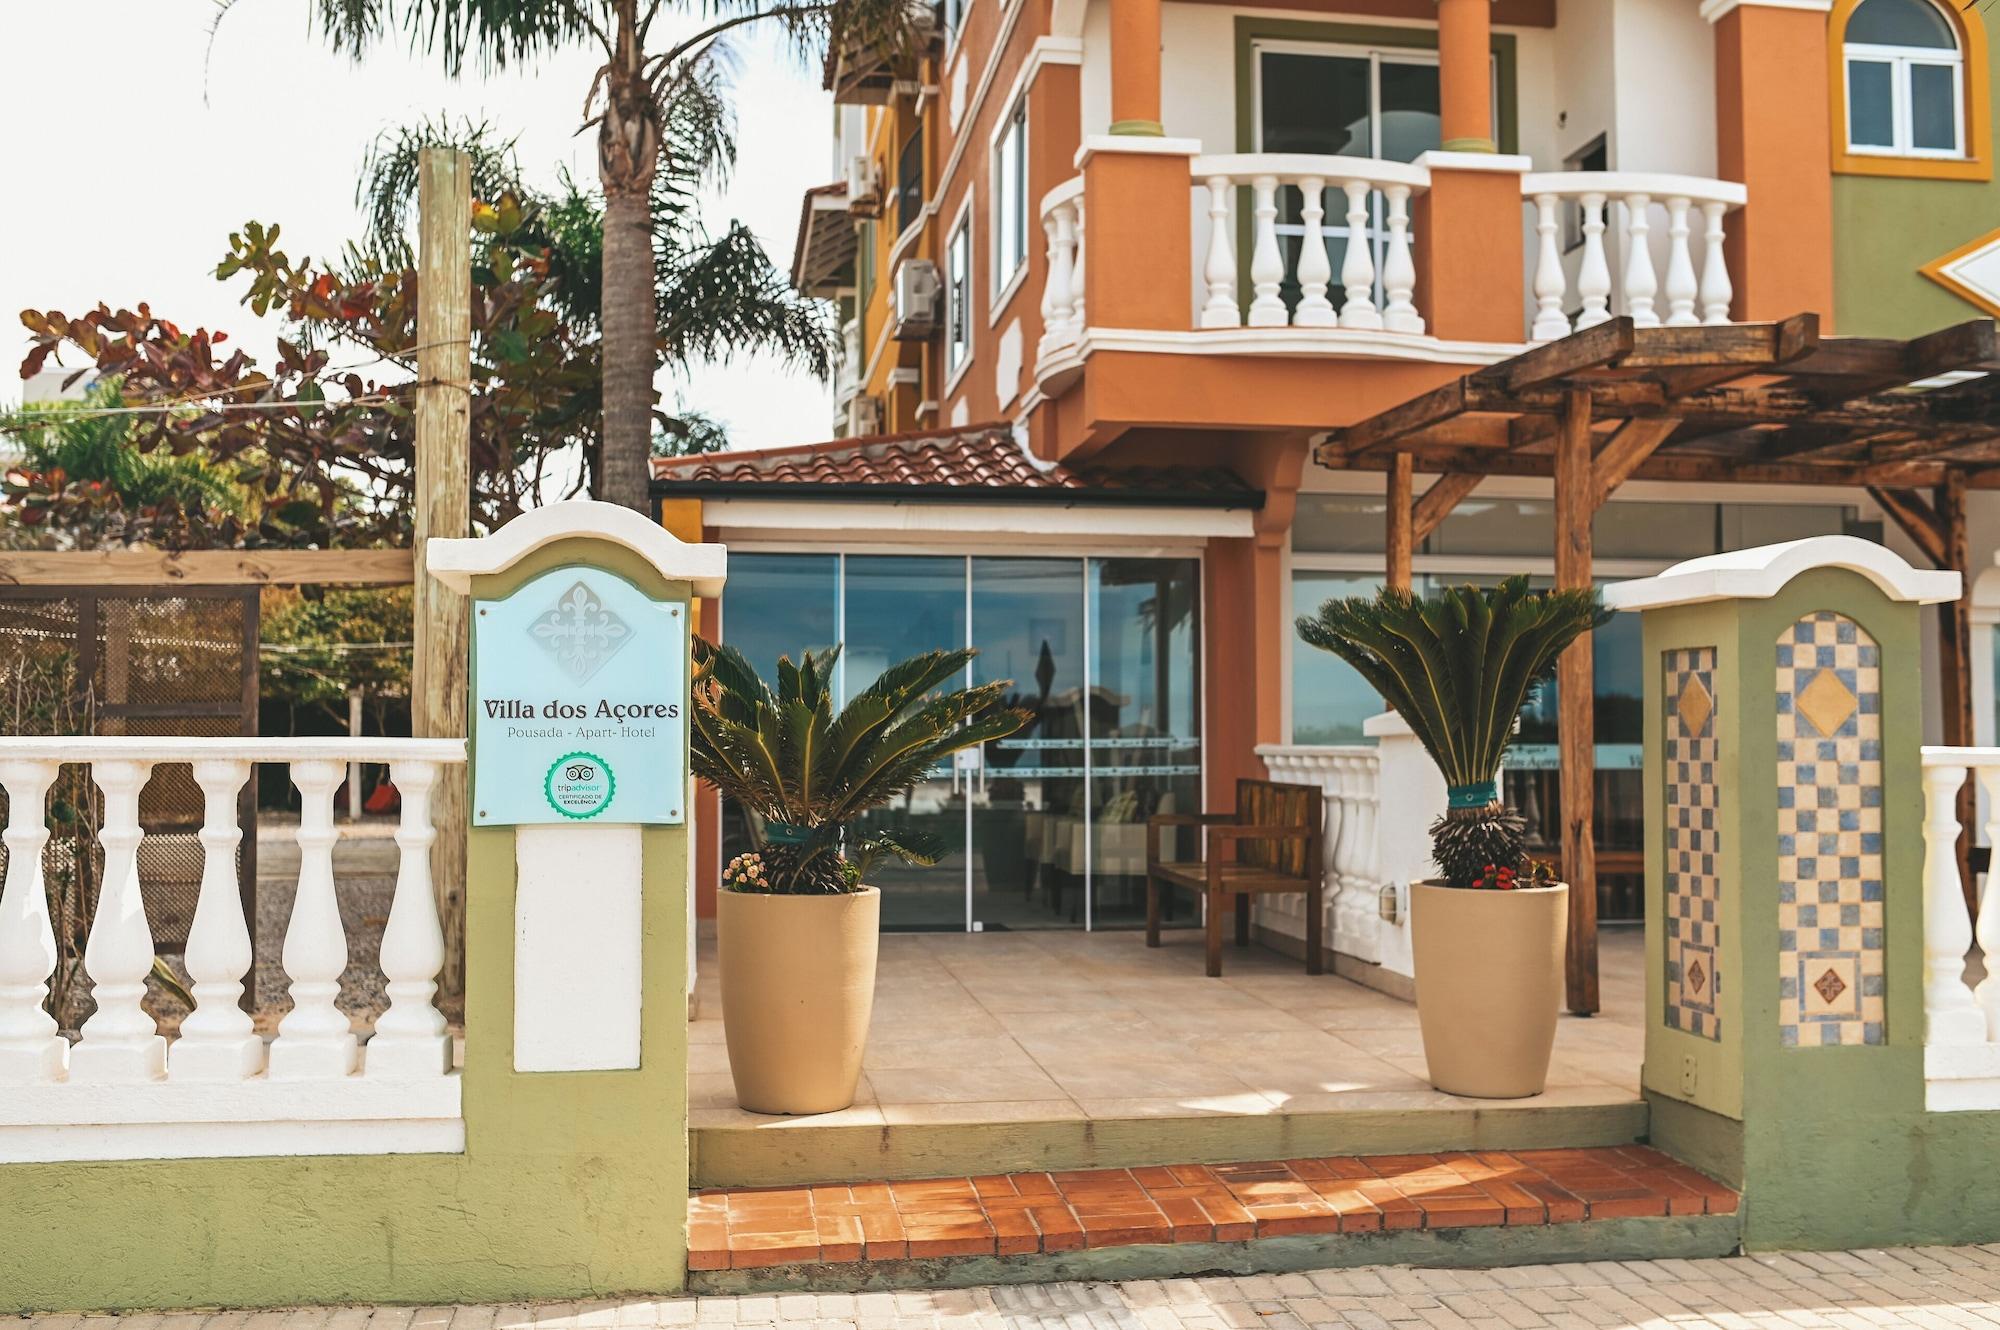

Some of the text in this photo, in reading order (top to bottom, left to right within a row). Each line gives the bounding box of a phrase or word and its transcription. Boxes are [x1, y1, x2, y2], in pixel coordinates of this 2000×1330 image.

[484, 699, 679, 724] Villa dos Açores
[508, 726, 563, 738] Pousada
[621, 726, 655, 738] Hotel
[557, 784, 600, 793] tripadvisor
